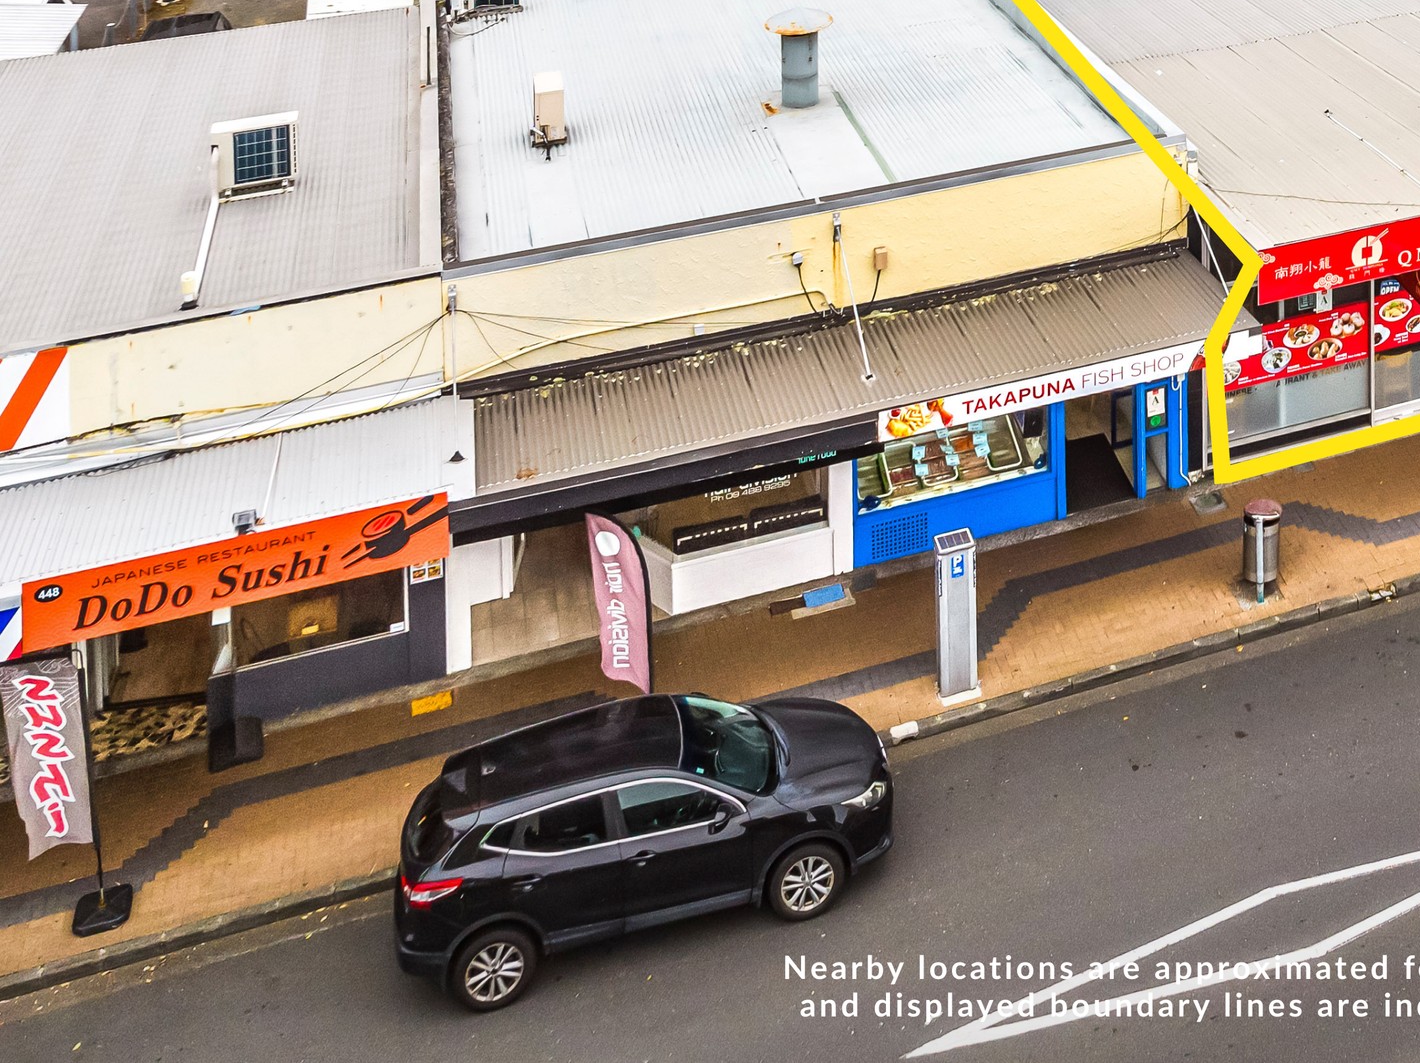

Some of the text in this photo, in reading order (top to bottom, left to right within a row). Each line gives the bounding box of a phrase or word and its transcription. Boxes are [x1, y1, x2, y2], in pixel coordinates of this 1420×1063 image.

[962, 352, 1184, 415] TAKAPUNA FISH SHOP
[710, 495, 725, 503] Ph
[91, 531, 316, 589] JAPANESE RESTAURANT
[952, 556, 963, 567] P
[38, 587, 60, 601] 448
[73, 545, 330, 632] DoDo Sushi
